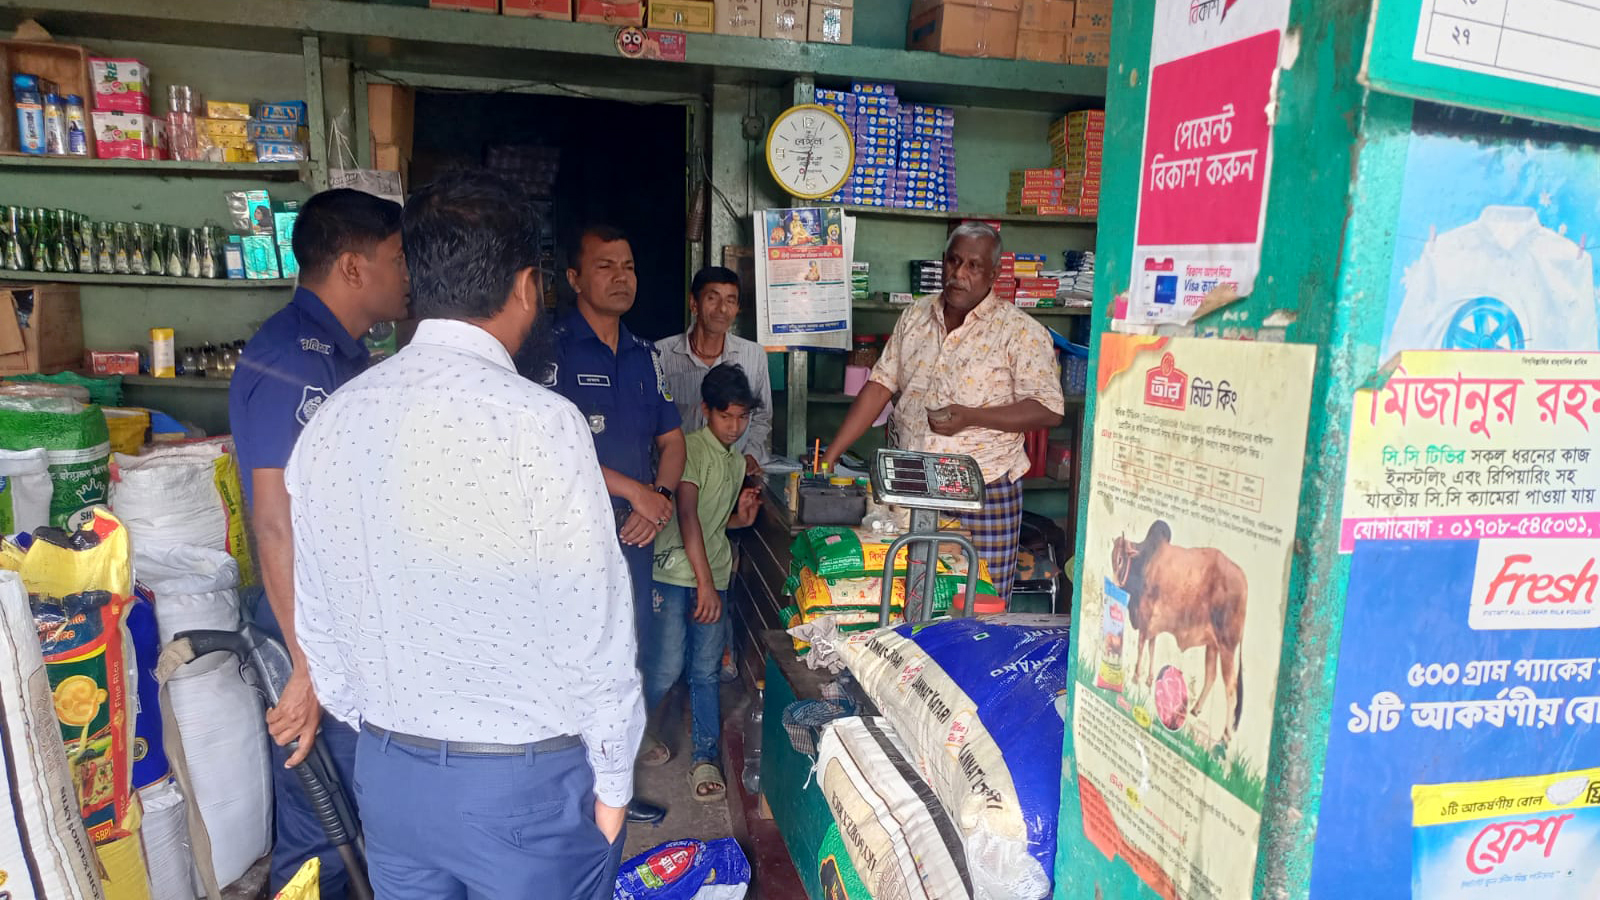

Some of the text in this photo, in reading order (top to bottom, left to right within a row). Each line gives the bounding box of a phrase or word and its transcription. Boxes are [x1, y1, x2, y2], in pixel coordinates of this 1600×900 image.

[1452, 26, 1470, 45] ২৭
[1174, 103, 1235, 151] পেমেন্ট
[1150, 149, 1258, 192] বিকাশ করুন
[1184, 279, 1200, 291] Visa
[1151, 376, 1238, 416] তীর মিট কিং
[1370, 365, 1525, 439] মিজানুর
[1425, 445, 1466, 465] টিভির
[1471, 449, 1507, 464] সকল
[1512, 448, 1556, 464] ধরনের
[1561, 447, 1592, 464] কাজ
[1452, 471, 1481, 486] এবং
[1487, 464, 1550, 485] রিপিয়ারিং
[1555, 469, 1577, 484] সহ
[1364, 487, 1419, 509] যাবতীয়
[1467, 490, 1520, 506] ক্যামেরা
[1525, 489, 1566, 505] পাওয়া
[1571, 488, 1596, 504] যায়
[1353, 518, 1432, 540] যোগাযোগ
[1484, 554, 1599, 605] Fresh
[1407, 657, 1596, 687] ৫০০ গ্রাম প্যাকের
[927, 690, 952, 724] KATARI
[1347, 691, 1405, 734] ১টি
[1411, 686, 1565, 730] আকর্ষণীয়
[1441, 801, 1459, 816] ১টি
[1462, 796, 1514, 813] আকর্ষণীয়
[1517, 796, 1544, 809] বোল
[1465, 814, 1575, 875] ফ্রেশ
